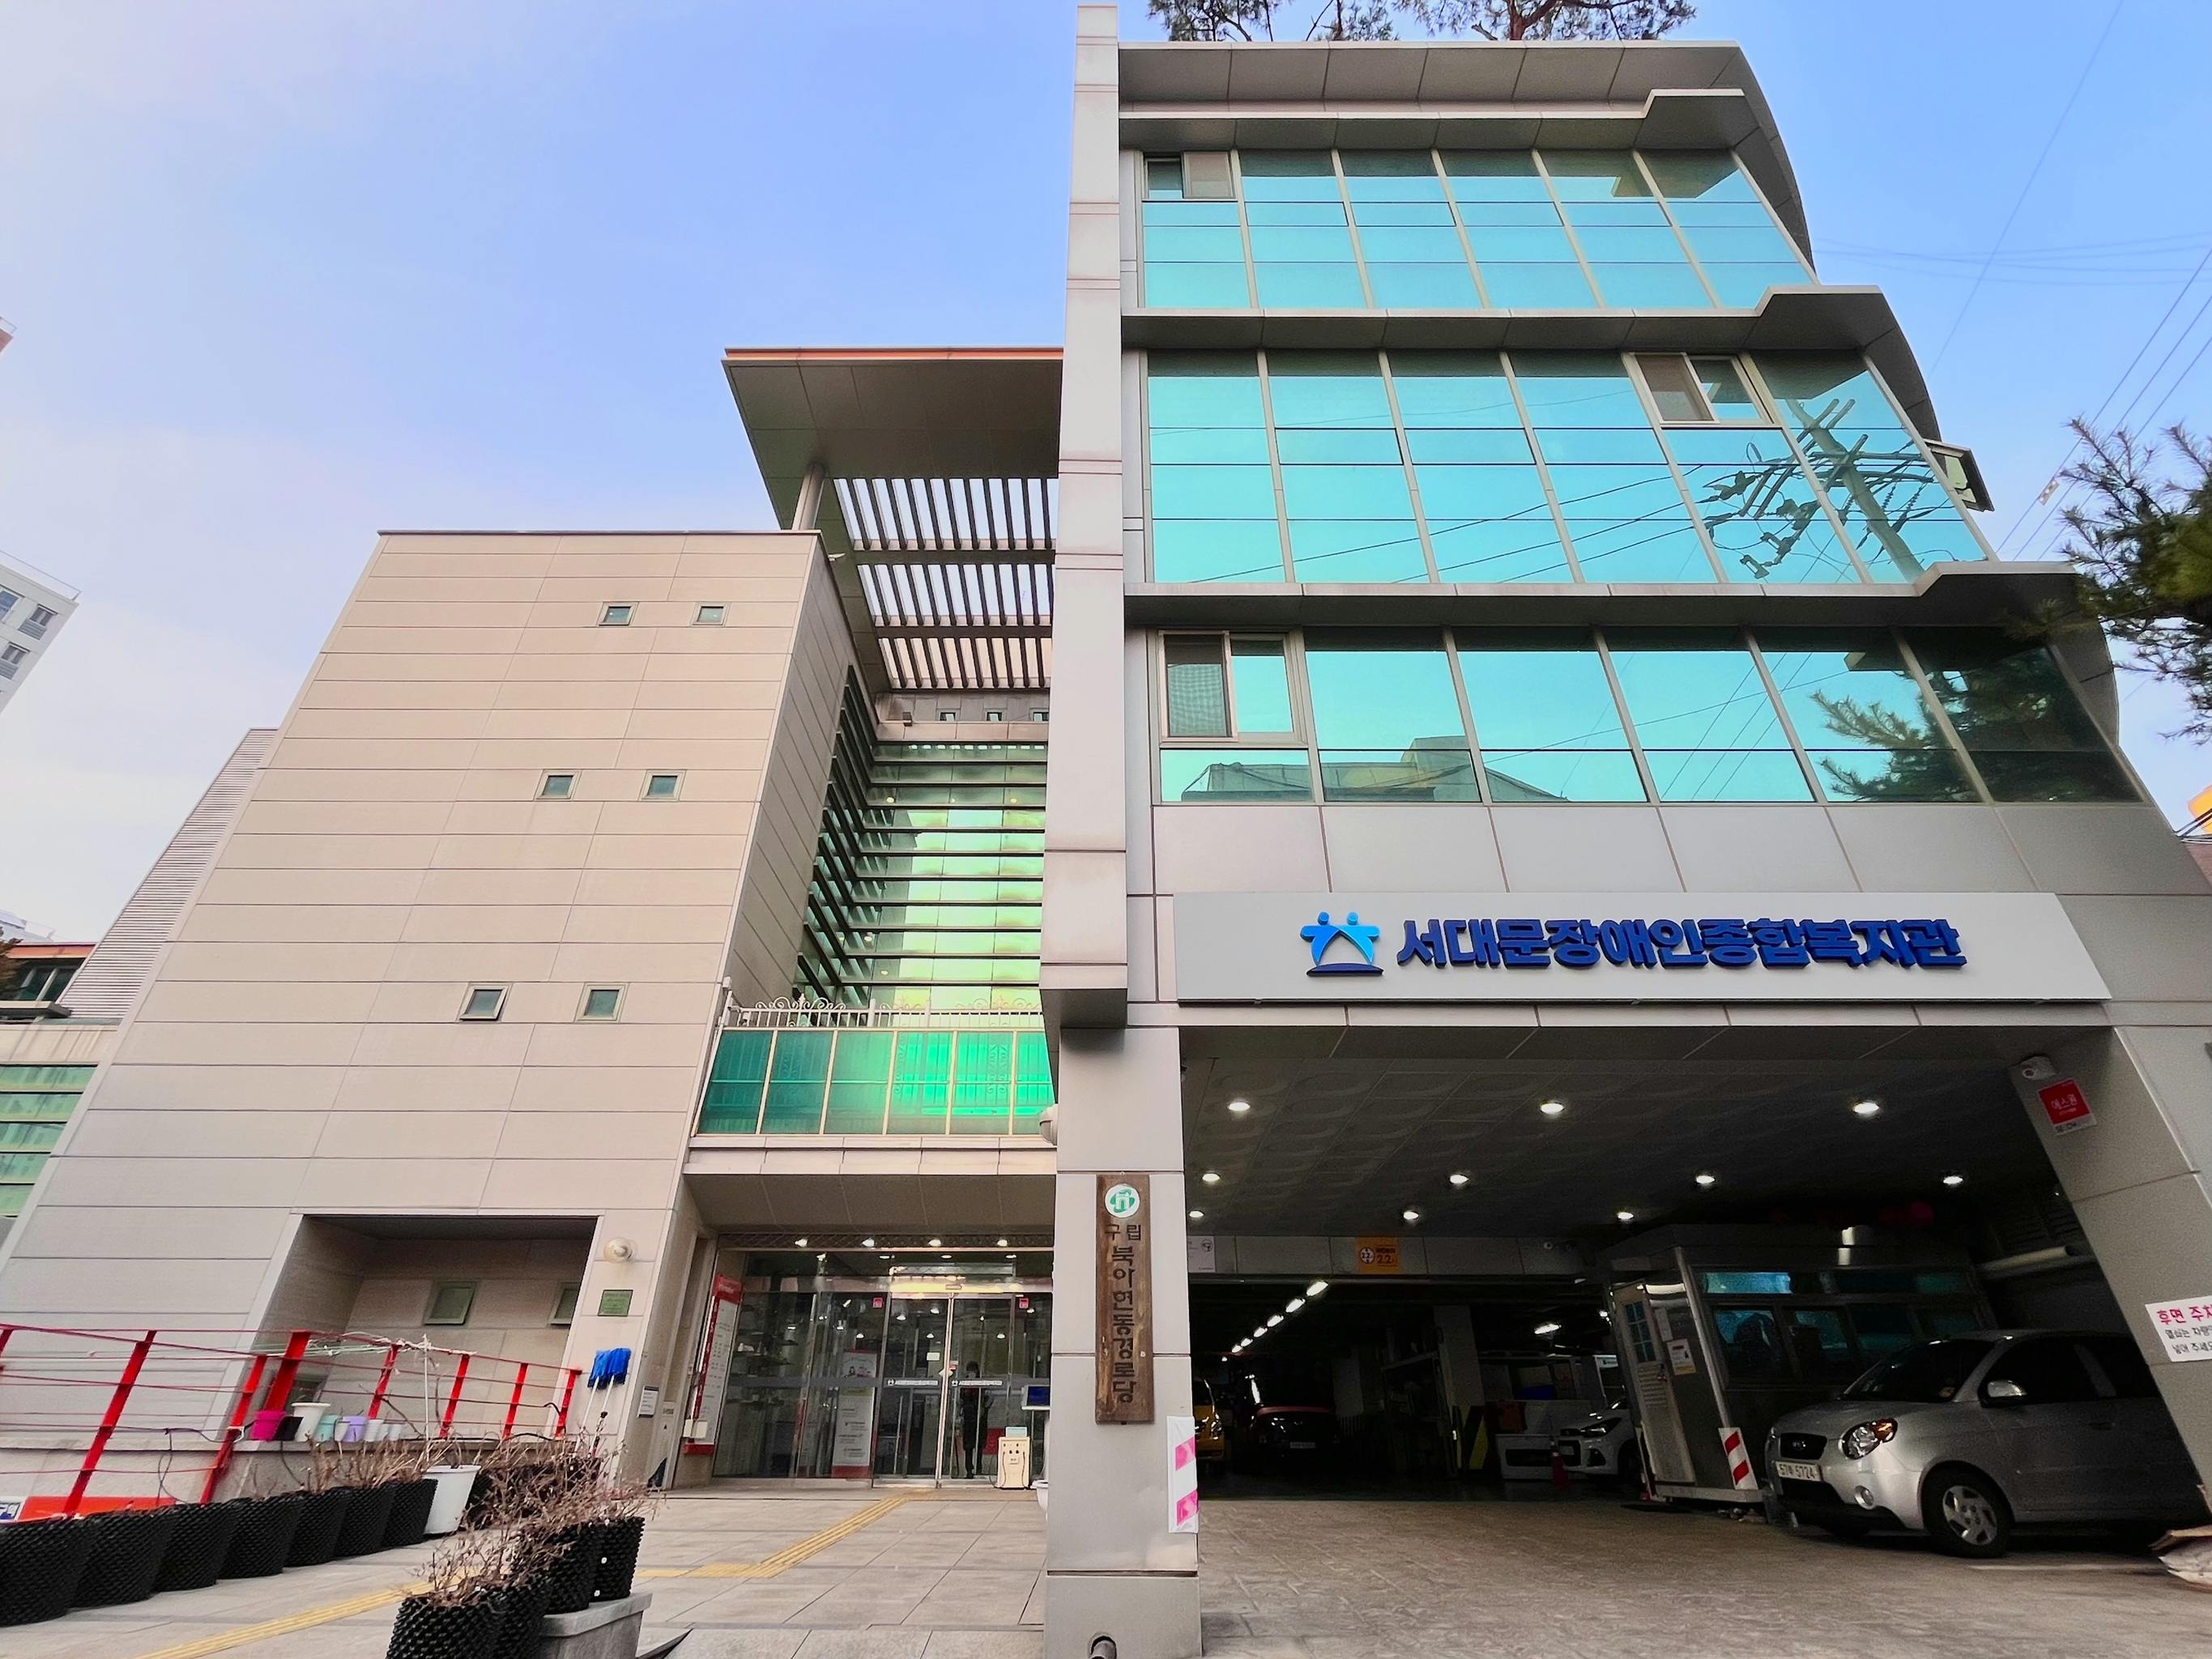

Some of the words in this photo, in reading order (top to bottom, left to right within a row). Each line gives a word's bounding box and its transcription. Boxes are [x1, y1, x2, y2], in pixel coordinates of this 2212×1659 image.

[1396, 918, 1967, 970] 서대문장애인종합복지관
[1104, 1224, 1142, 1241] 구립
[1111, 1245, 1137, 1405] 북아현동경로당
[2156, 1308, 2186, 1324] 후면
